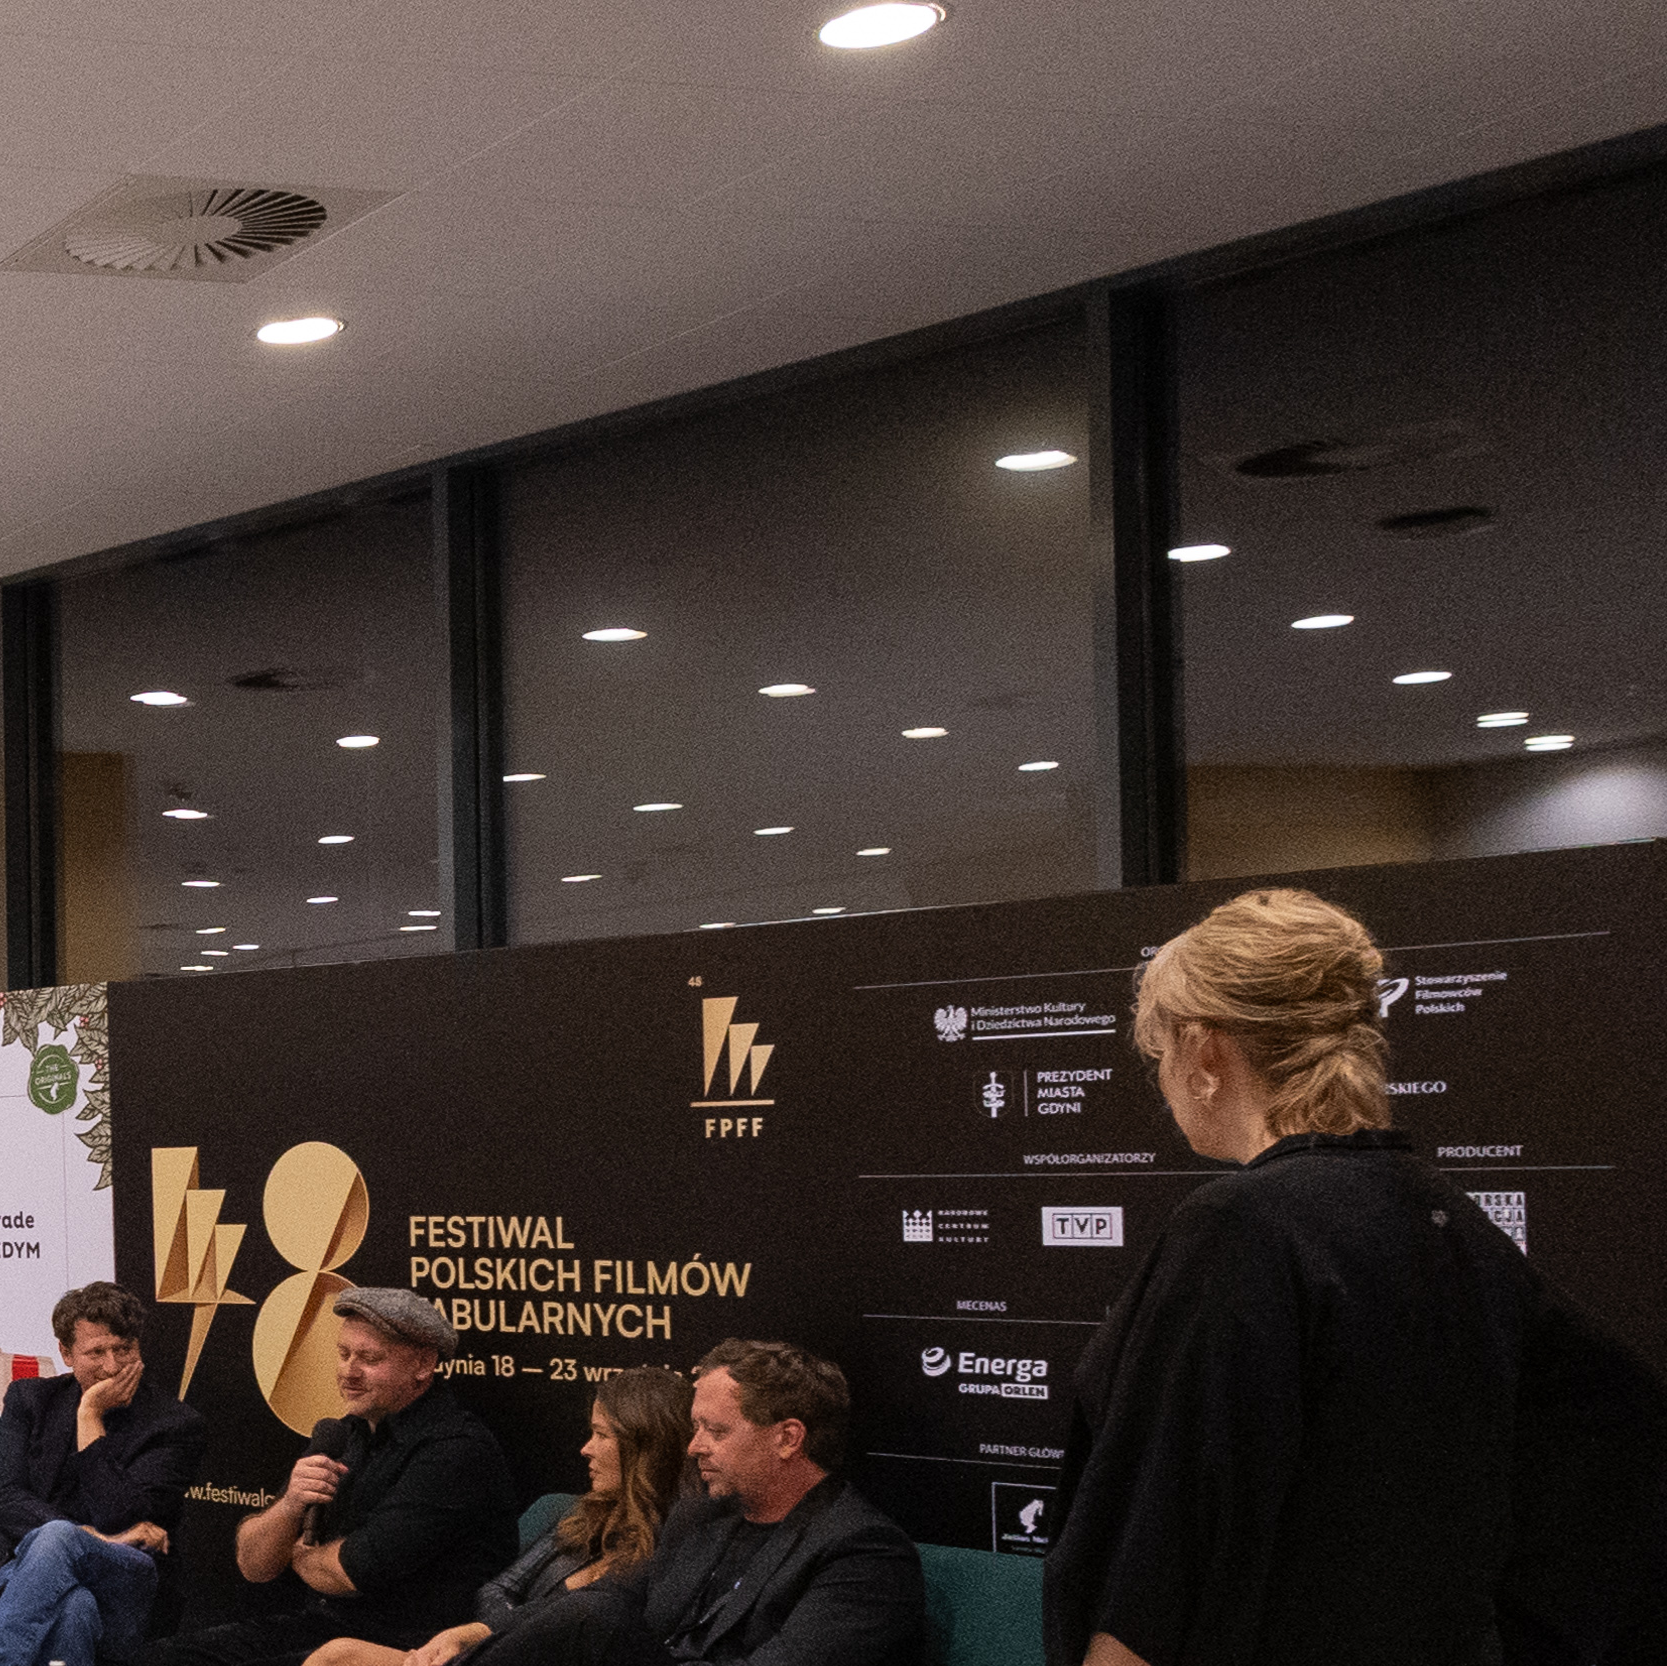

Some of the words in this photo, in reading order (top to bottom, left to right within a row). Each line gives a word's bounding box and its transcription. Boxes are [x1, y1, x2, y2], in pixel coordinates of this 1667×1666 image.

[971, 1005, 1041, 1017] Ministerstwo
[1043, 1001, 1086, 1014] Kultury
[1415, 1001, 1465, 1014] Polskich
[976, 1017, 1042, 1030] Dziedzictwa
[1044, 1014, 1116, 1028] Narodowego
[1037, 1069, 1113, 1083] PREZYDENT
[1037, 1086, 1085, 1098] MIASTA
[1385, 1081, 1447, 1094] SKIEGO
[1037, 1102, 1082, 1115] GDYNI
[705, 1117, 763, 1138] FPFF
[1437, 1145, 1524, 1157] PRODUCENT
[1023, 1152, 1156, 1165] WSPÓŁORGANIZATORZY
[409, 1216, 575, 1249] FESTIWAL
[1056, 1218, 1108, 1235] TVP
[411, 1256, 581, 1293] POLSKICH
[594, 1252, 752, 1298] FILMÓW
[956, 1300, 1007, 1312] MECENAS
[491, 1355, 514, 1378] 18
[549, 1358, 577, 1381] 23
[957, 1352, 1049, 1383] Energa
[958, 1383, 1001, 1395] GRUPA
[1005, 1385, 1046, 1398] ORLEN
[979, 1443, 1027, 1457] PARTNER
